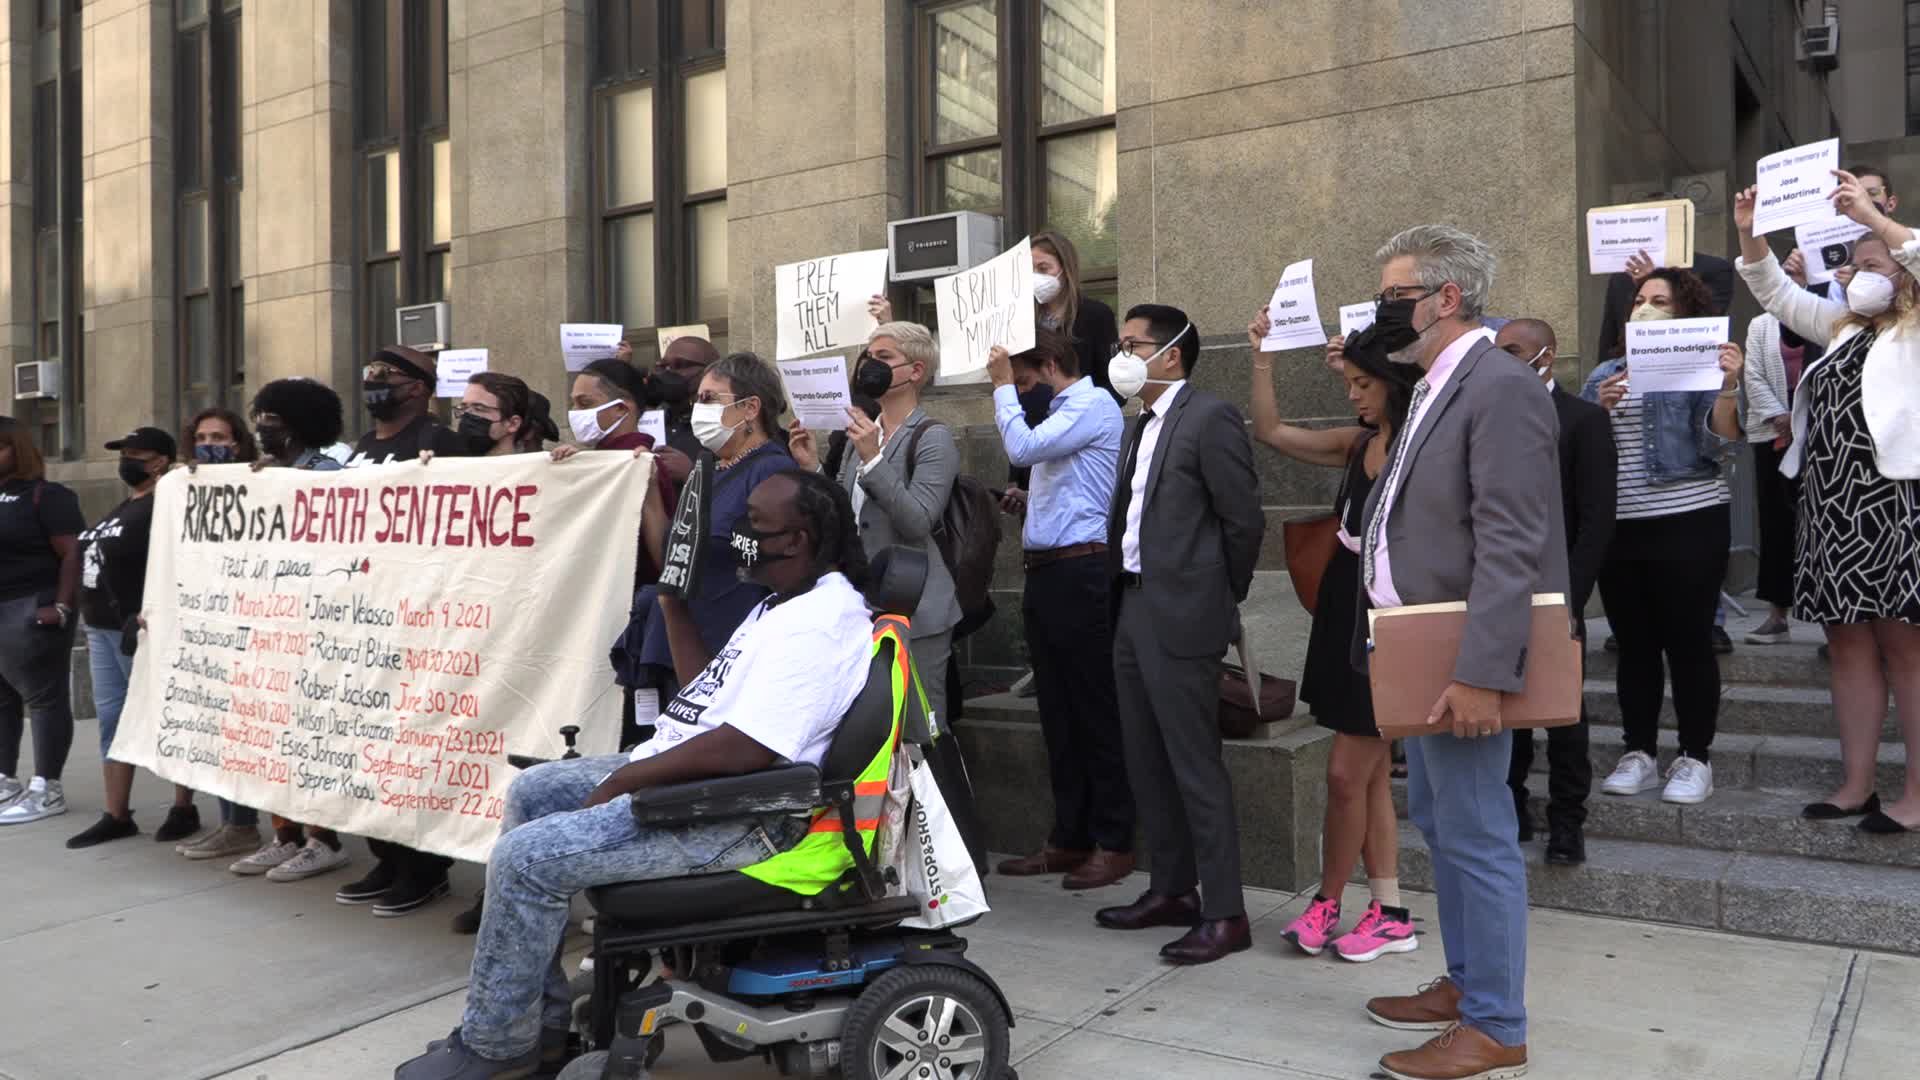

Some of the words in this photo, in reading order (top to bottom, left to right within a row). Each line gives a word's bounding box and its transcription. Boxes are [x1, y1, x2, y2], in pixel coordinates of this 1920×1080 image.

[1780, 176, 1799, 187] Jose
[1782, 187, 1821, 202] Martinez
[796, 257, 838, 299] FREE
[793, 291, 839, 331] THEM
[1635, 327, 1646, 337] We
[1647, 327, 1666, 336] honor
[1668, 326, 1680, 335] the
[1681, 324, 1710, 334] memory
[1711, 323, 1720, 333] of
[804, 325, 839, 352] ALL
[1631, 345, 1672, 356] Brandon
[1673, 341, 1724, 354] Rodriguez
[181, 484, 248, 543] RIKERS
[268, 504, 286, 542] A
[291, 486, 369, 544] DEATH
[375, 485, 538, 548] SENTENCE
[250, 554, 268, 581] in
[310, 594, 350, 622] Javier
[352, 592, 394, 626] Velasco
[397, 597, 435, 628] March
[442, 602, 450, 629] 9
[456, 602, 492, 629] 2021
[315, 631, 363, 664] Richard
[364, 637, 403, 670] Blake
[443, 650, 480, 676] 2021
[300, 668, 338, 703] Robert
[338, 672, 391, 710] Jackson
[394, 682, 422, 713] June
[424, 689, 446, 714] 30
[448, 692, 480, 718] 2021
[296, 703, 326, 733] Wilson
[327, 707, 394, 742] Diaz-Guzman
[394, 715, 444, 752] January
[445, 725, 463, 752] 23
[464, 730, 505, 756] 2021
[281, 731, 310, 760] Esias
[311, 735, 358, 772] Johnson
[361, 743, 428, 784] September
[431, 757, 442, 785] 7
[447, 760, 490, 791] 2021
[379, 779, 459, 816] September
[459, 791, 482, 816] 22
[484, 796, 506, 820] 20
[915, 801, 942, 897] STOP&SHOP
